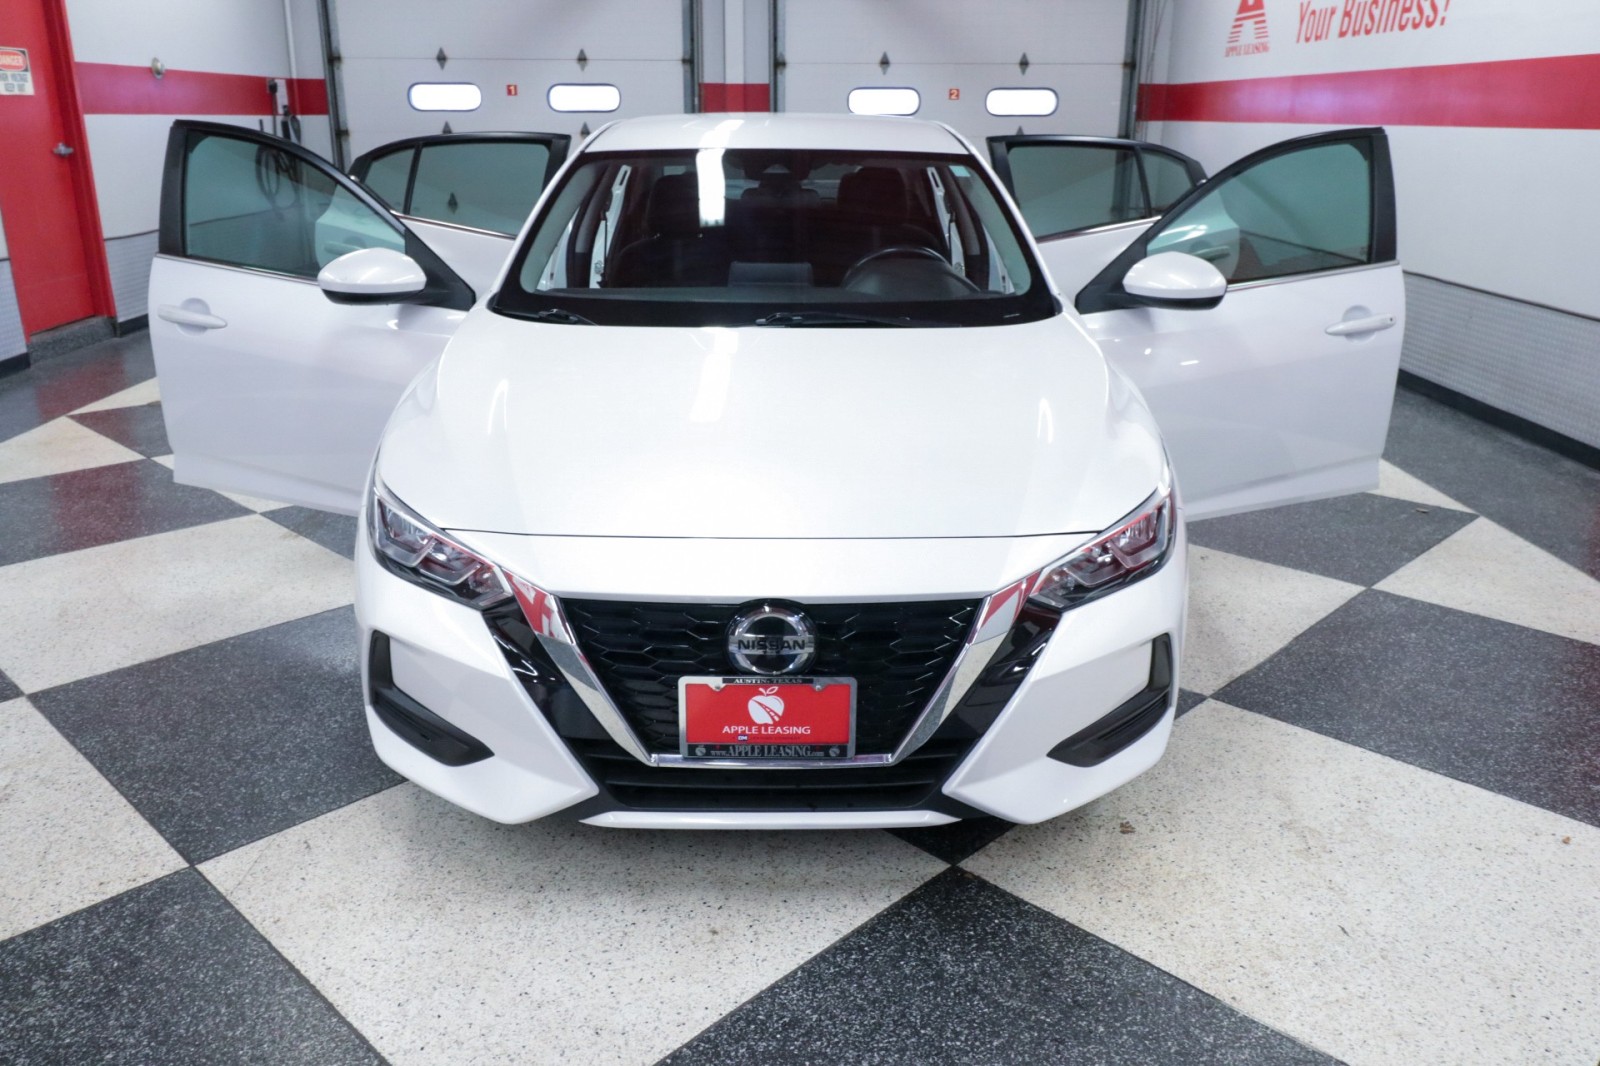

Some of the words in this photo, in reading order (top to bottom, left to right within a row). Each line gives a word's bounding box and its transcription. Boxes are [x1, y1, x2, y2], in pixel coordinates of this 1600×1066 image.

[1296, 0, 1337, 43] Your
[950, 89, 958, 99] 2
[738, 639, 806, 650] NISSAN
[722, 726, 758, 734] APPLE
[761, 726, 811, 735] LEASING
